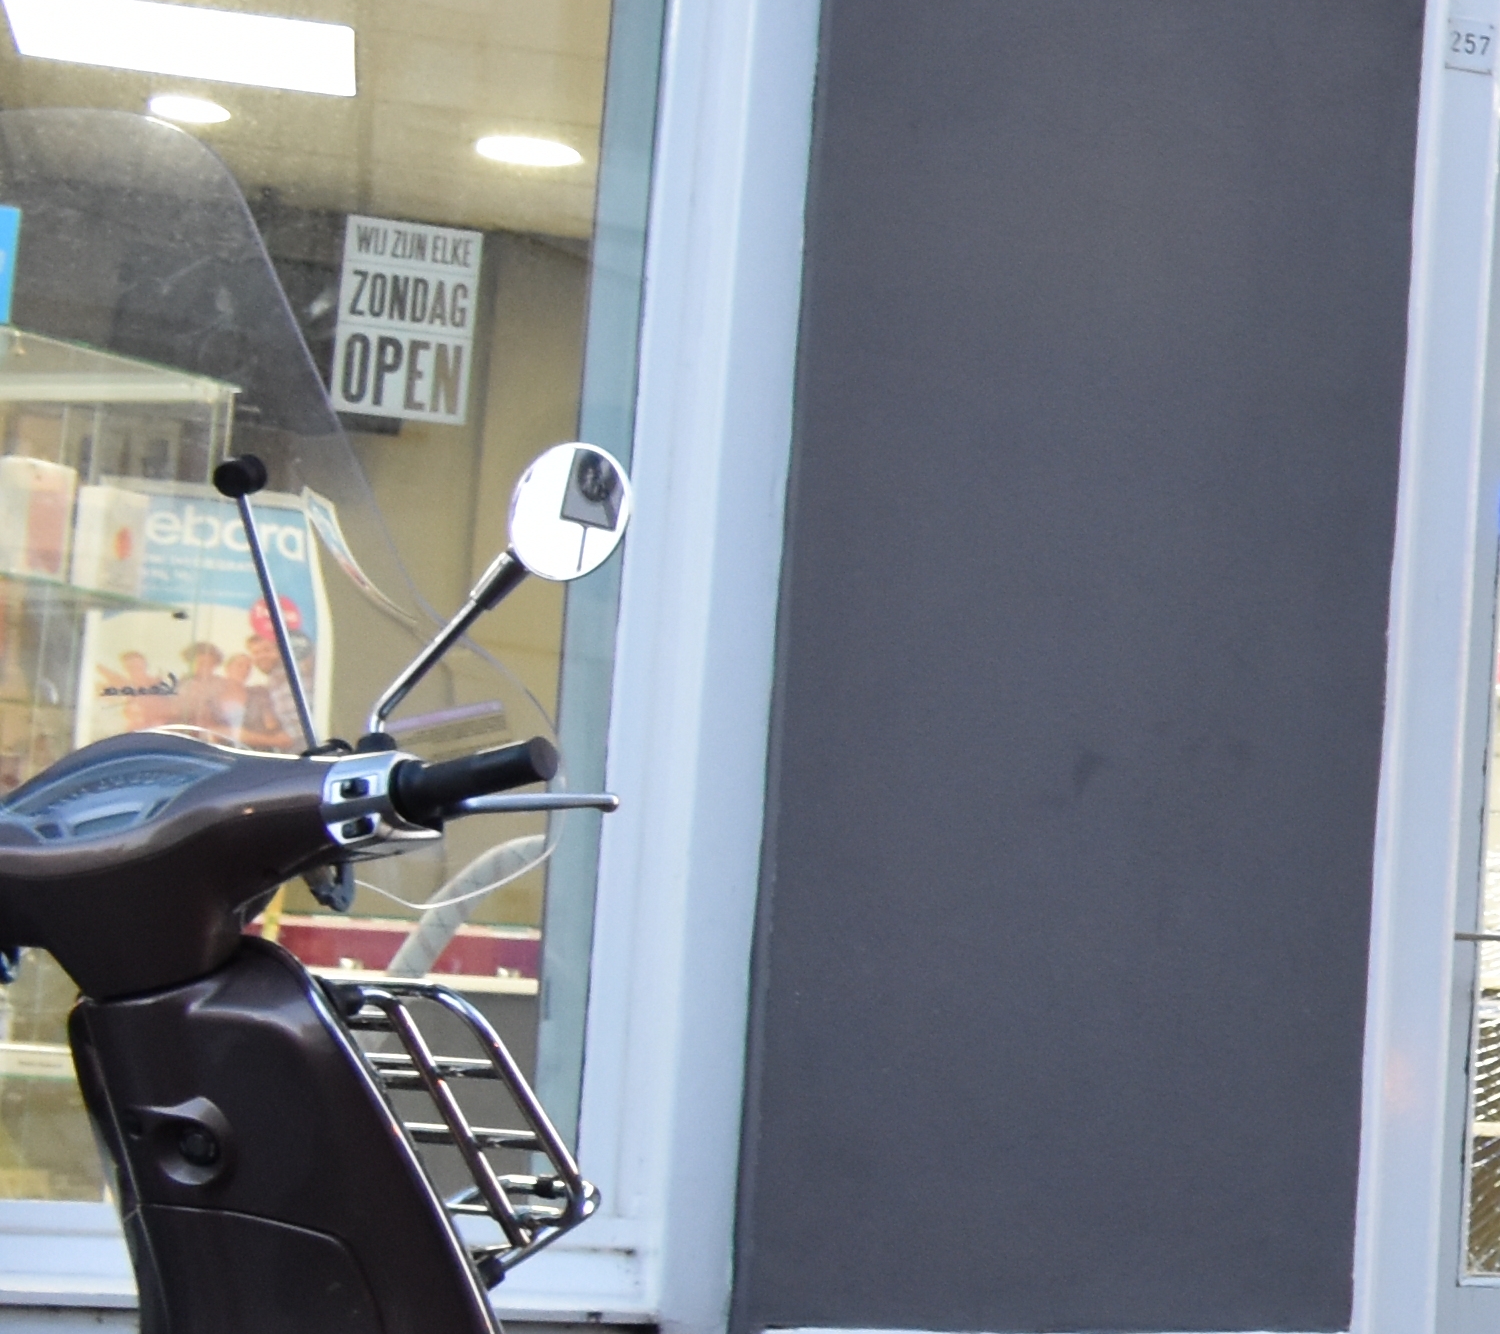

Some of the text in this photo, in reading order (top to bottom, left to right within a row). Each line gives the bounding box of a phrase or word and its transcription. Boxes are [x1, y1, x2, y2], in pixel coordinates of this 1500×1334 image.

[1450, 29, 1491, 56] 257
[356, 225, 474, 268] WIJ ZIJN ELKE
[349, 269, 469, 328] ZONDAG
[341, 333, 464, 416] OPEN
